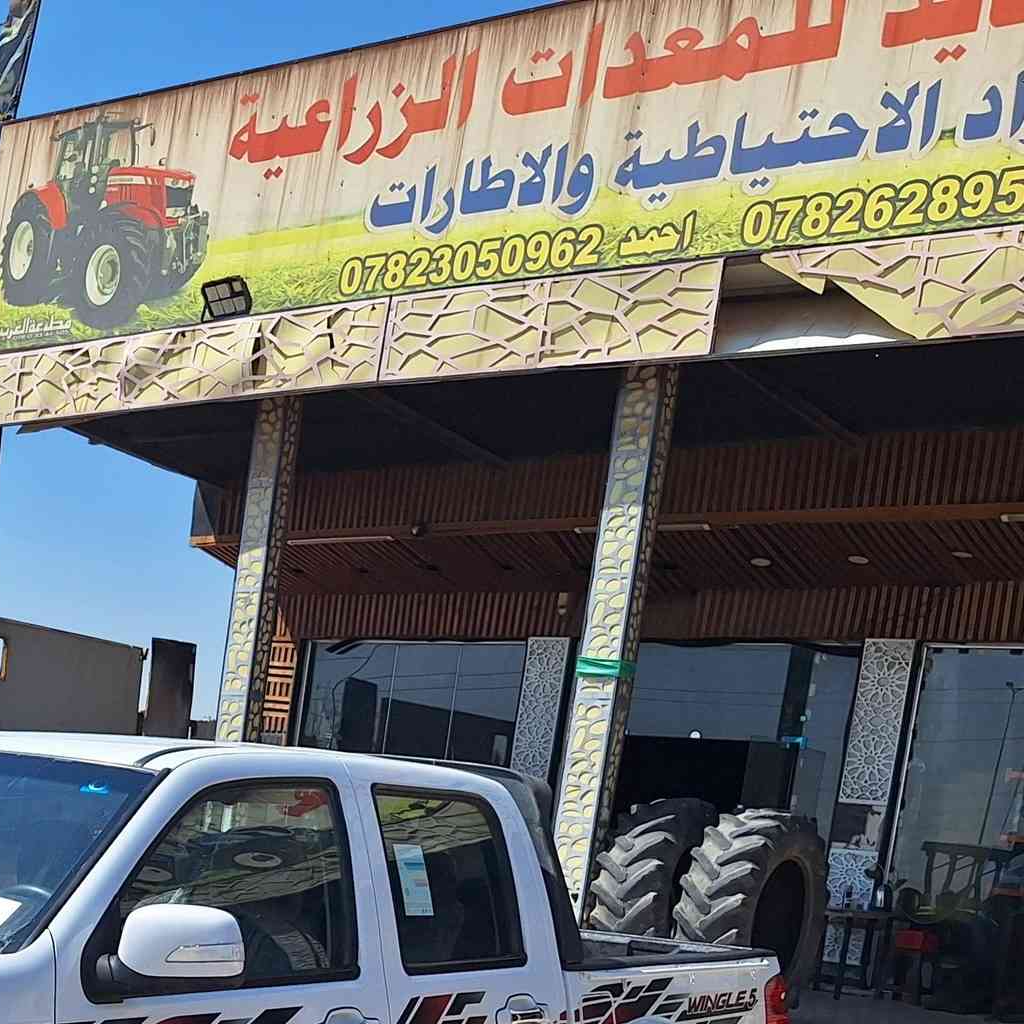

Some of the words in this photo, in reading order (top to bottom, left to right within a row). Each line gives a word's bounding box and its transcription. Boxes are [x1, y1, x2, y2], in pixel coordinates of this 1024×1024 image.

[501, 0, 848, 116] للمعدات
[229, 48, 481, 180] الزراعية
[614, 78, 942, 206] الاحتياطية
[370, 142, 594, 235] والاطارات
[740, 166, 1024, 248] 078262895
[339, 224, 604, 296] 07823050962
[619, 210, 697, 257] احمد
[688, 990, 747, 1012] WINGLE
